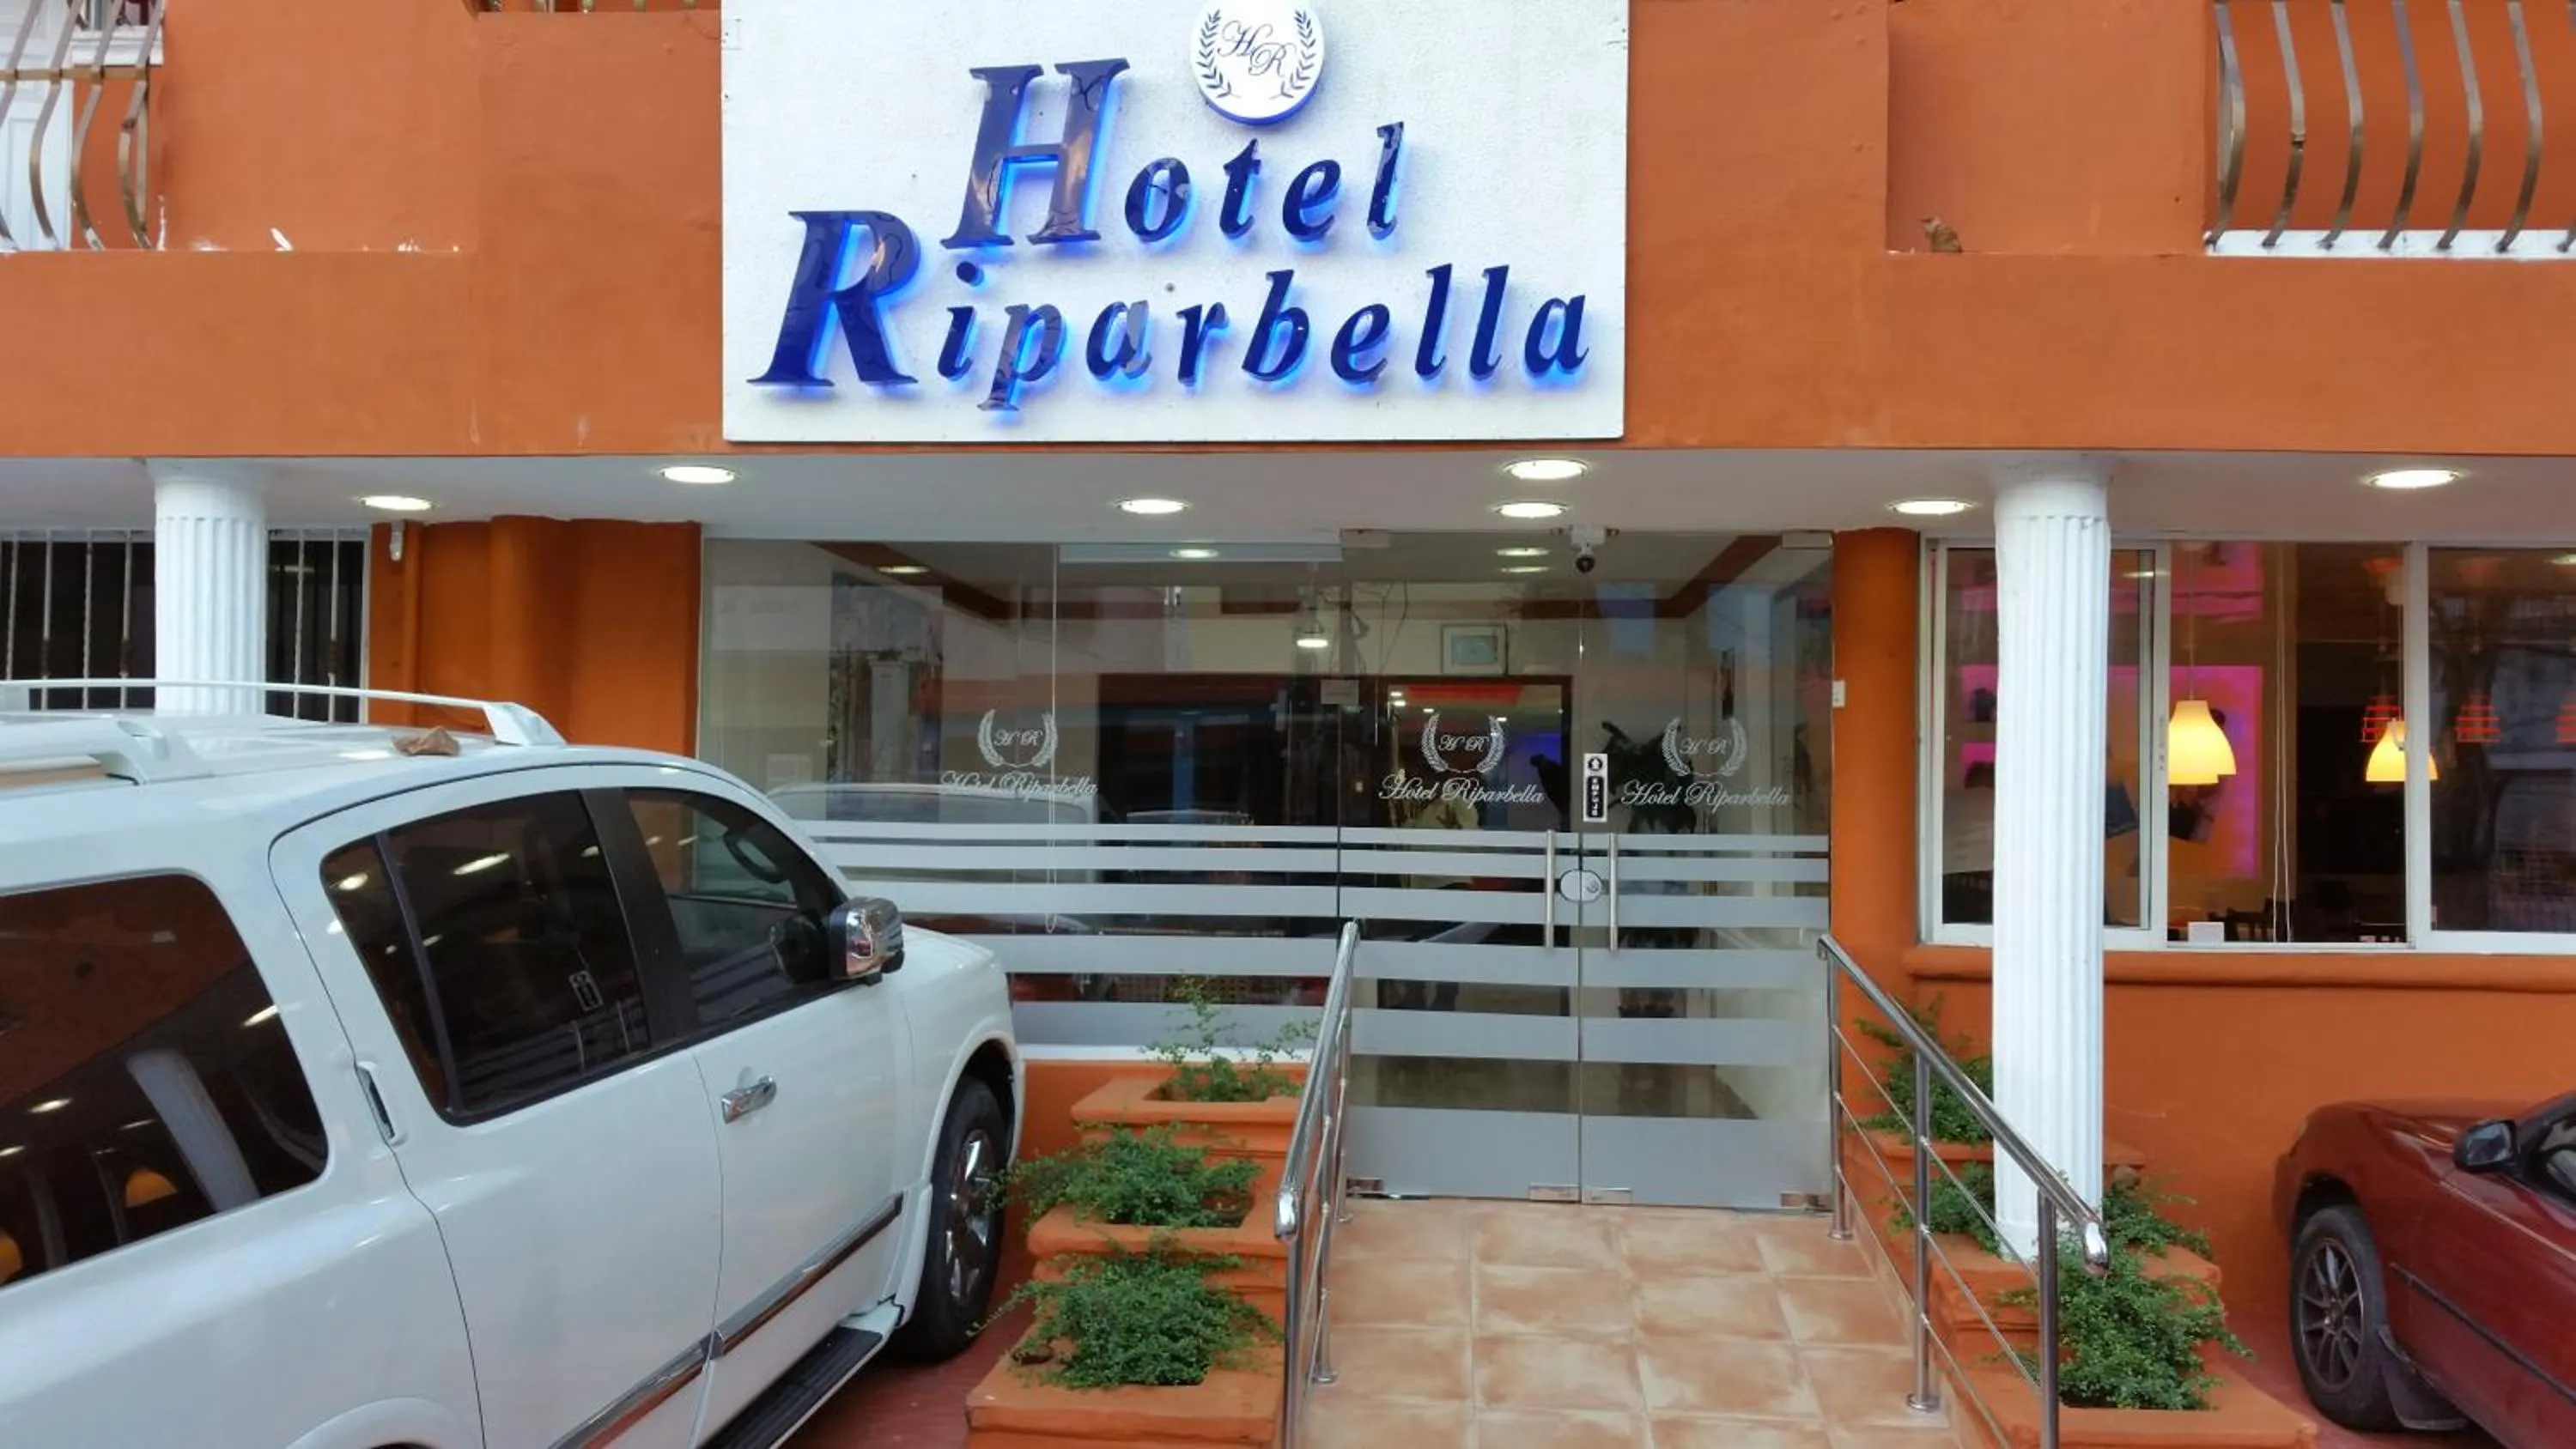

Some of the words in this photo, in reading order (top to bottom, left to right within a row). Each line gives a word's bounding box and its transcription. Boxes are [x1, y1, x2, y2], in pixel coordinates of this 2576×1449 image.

[939, 57, 1406, 250] Hotel
[746, 209, 1591, 413] Riparbella
[941, 770, 995, 794] Hotel
[999, 771, 1098, 803] Riparbella
[1378, 774, 1437, 800] Hotel
[1440, 777, 1545, 809] Riparbella
[1620, 779, 1683, 805] Hotel
[1684, 780, 1790, 814] Riparbella
